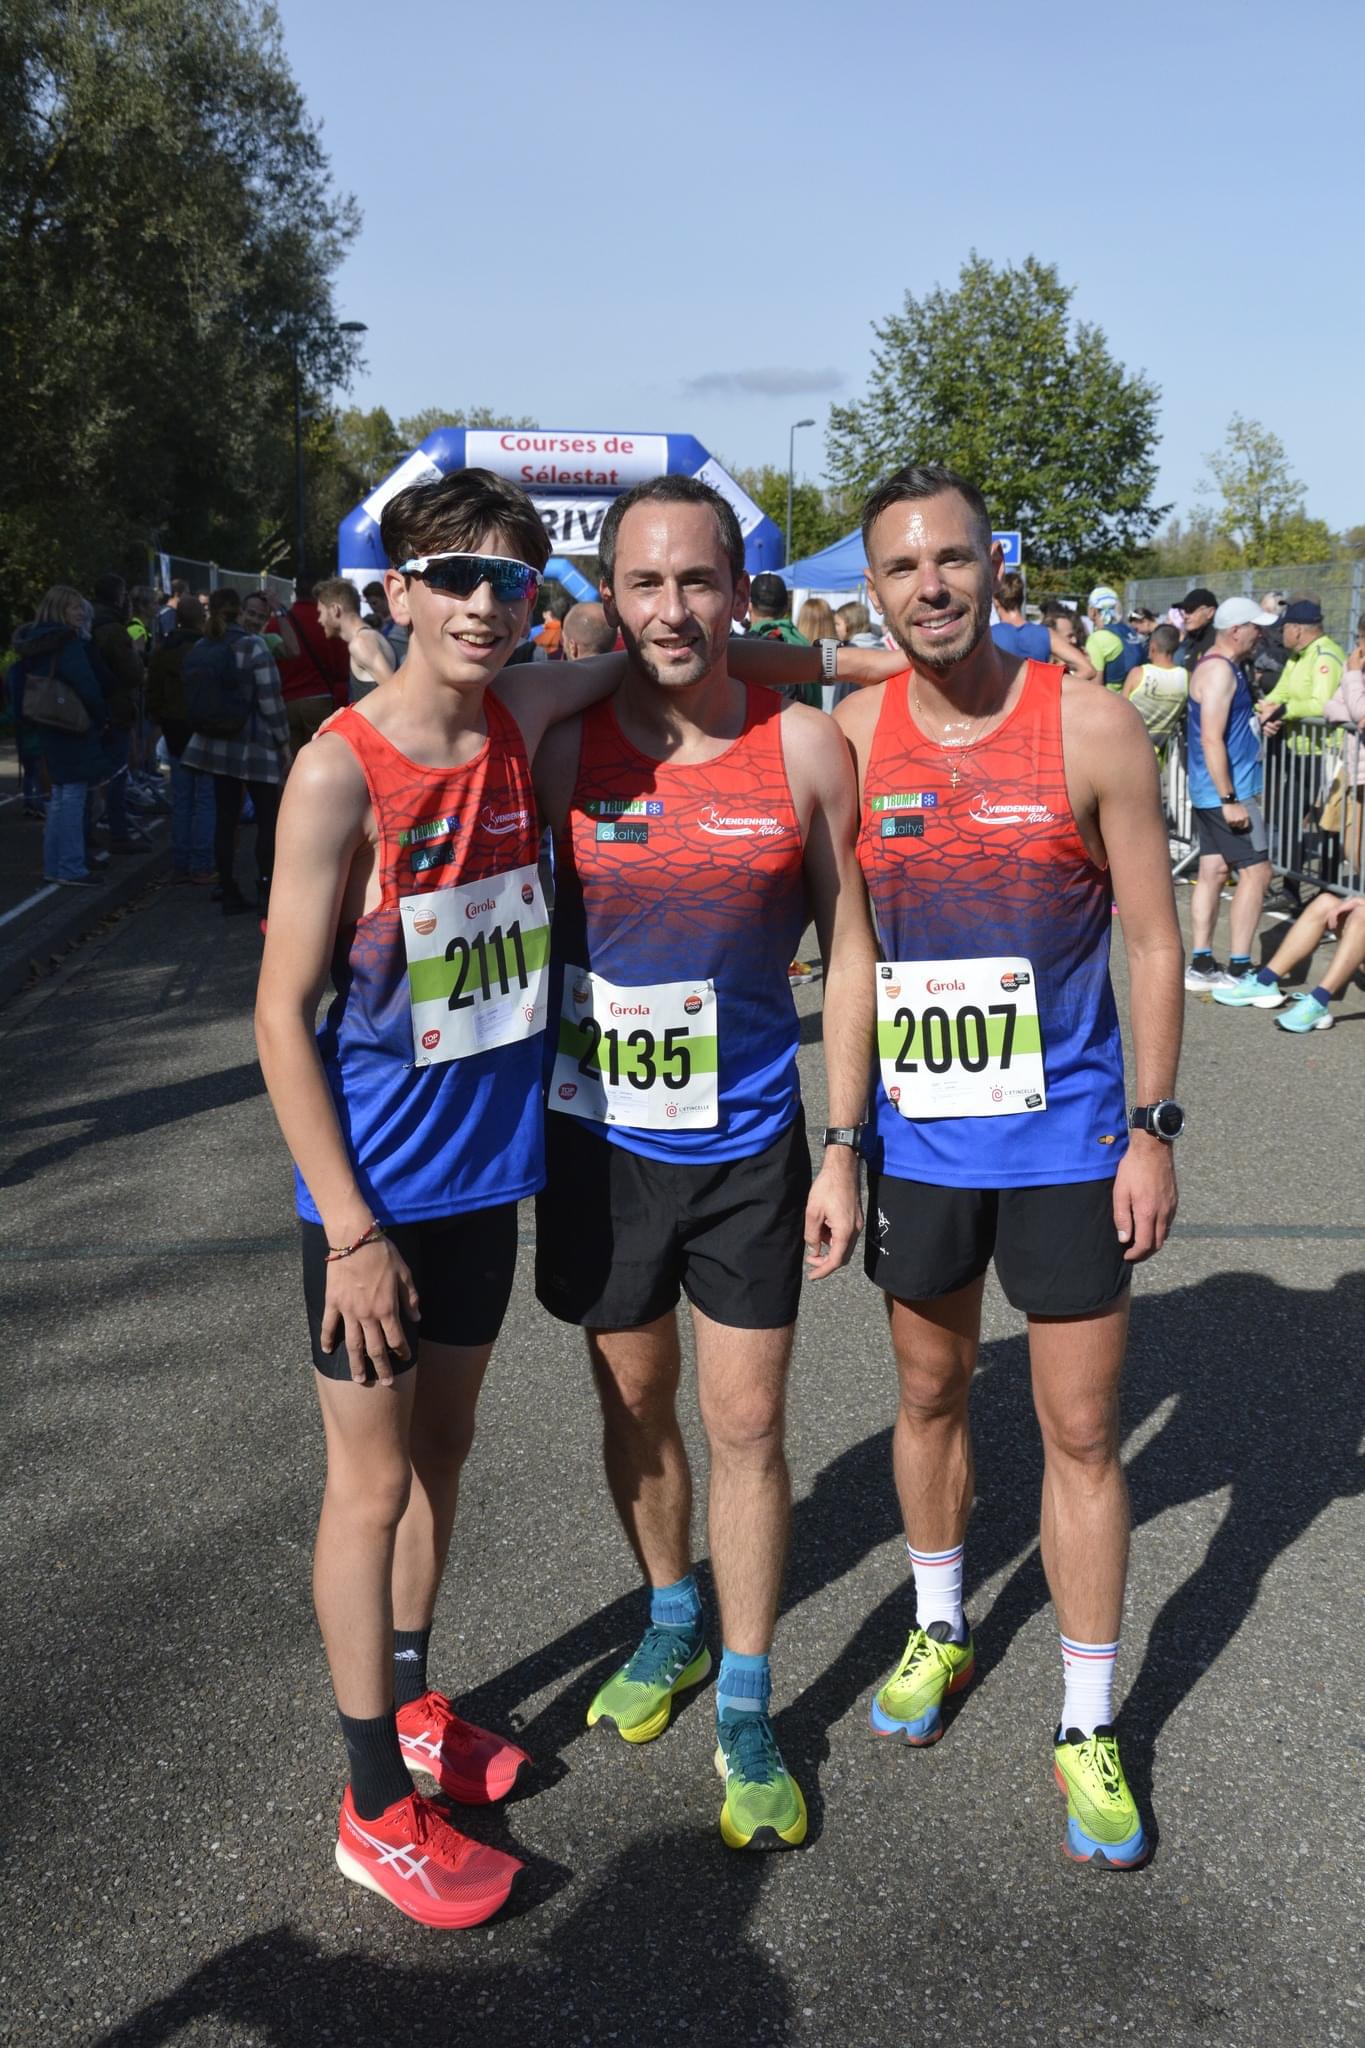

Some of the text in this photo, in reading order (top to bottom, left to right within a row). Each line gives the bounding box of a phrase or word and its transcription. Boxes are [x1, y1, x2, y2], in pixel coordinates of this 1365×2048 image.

[500, 434, 634, 454] Courses de
[519, 465, 619, 485] Sélestat
[604, 800, 644, 815] TRUMPF
[887, 793, 920, 809] TRUMPF
[988, 805, 1048, 814] VENDENHEIM
[718, 817, 778, 826] VENDENHEIM
[885, 821, 924, 836] exaltys
[602, 826, 648, 843] exaltys
[465, 898, 496, 920] Carola
[445, 920, 528, 1011] 2111
[926, 978, 966, 995] Carola
[610, 1001, 650, 1017] Carola
[423, 1032, 439, 1044] TOP
[893, 1003, 1017, 1074] 2007
[578, 1017, 691, 1090] 2135
